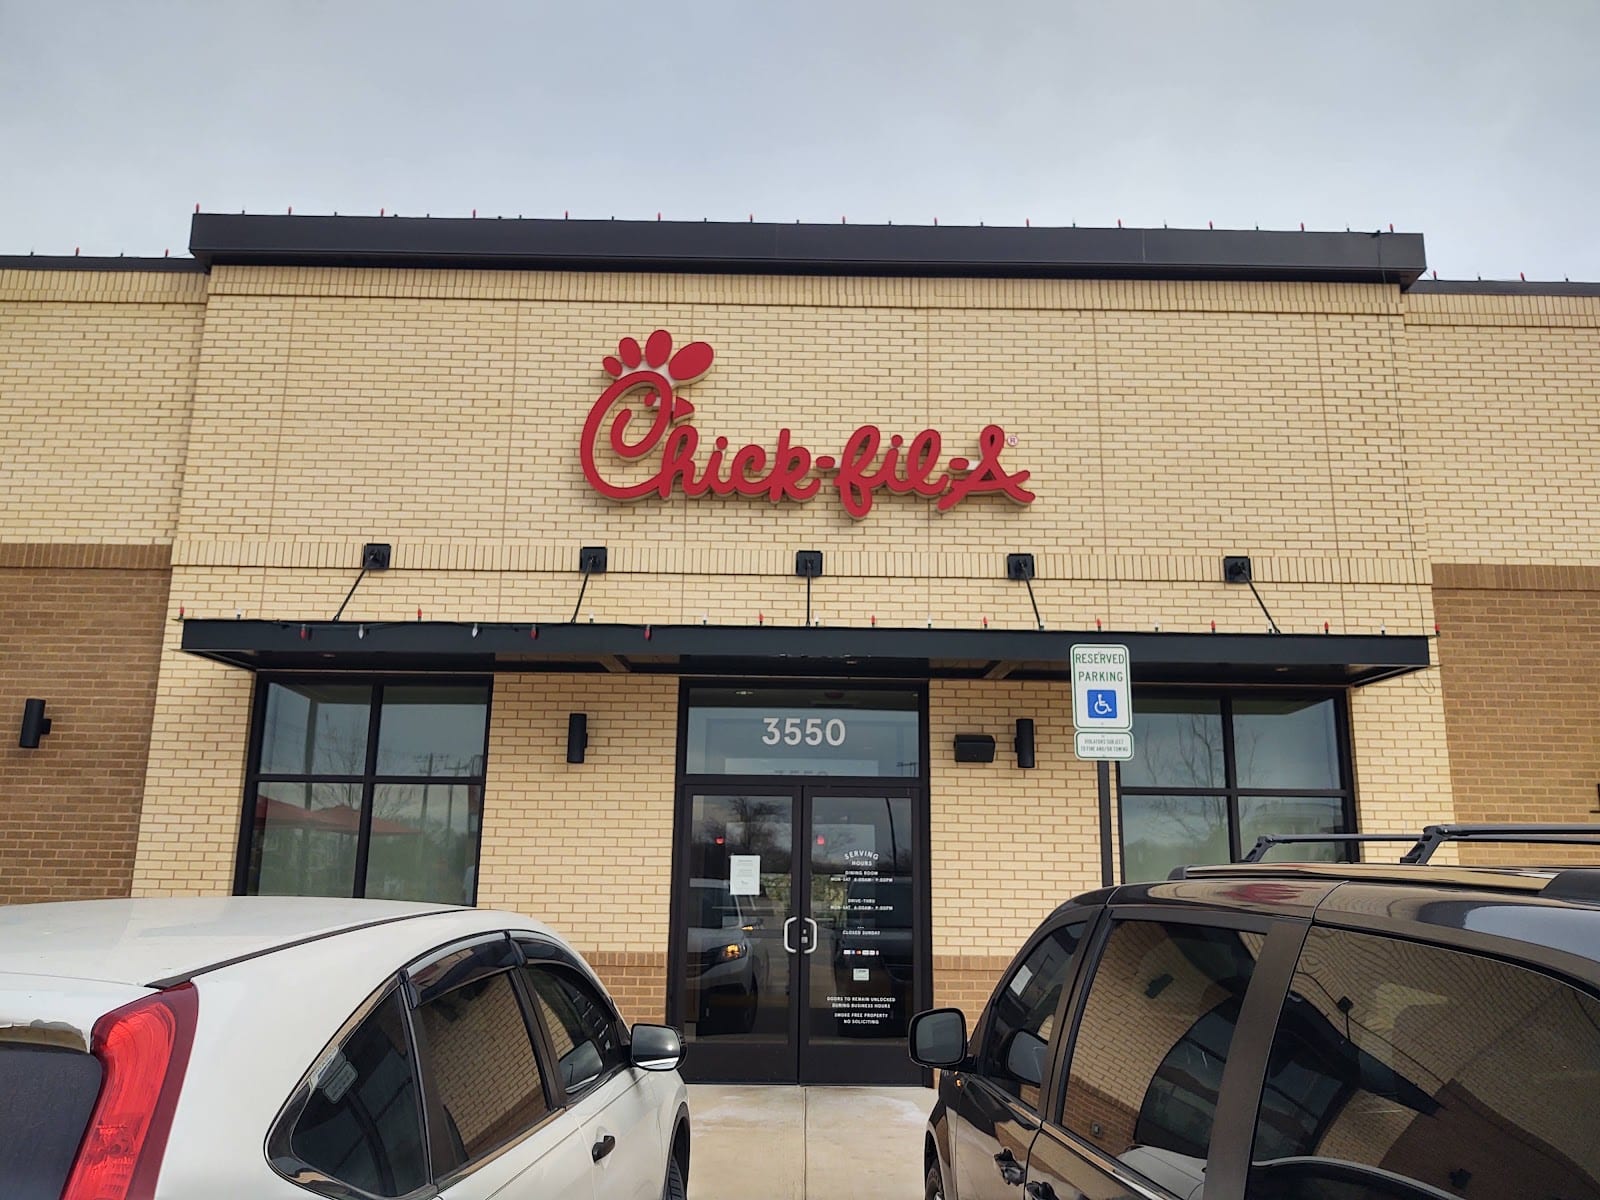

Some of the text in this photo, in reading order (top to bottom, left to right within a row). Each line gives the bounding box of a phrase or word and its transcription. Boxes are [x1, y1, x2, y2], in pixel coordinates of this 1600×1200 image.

[580, 366, 1036, 520] Chick-fil-A
[1075, 653, 1125, 664] RESERVED
[1078, 671, 1123, 682] PARKING
[762, 717, 846, 746] 3550
[844, 850, 879, 860] SERVING
